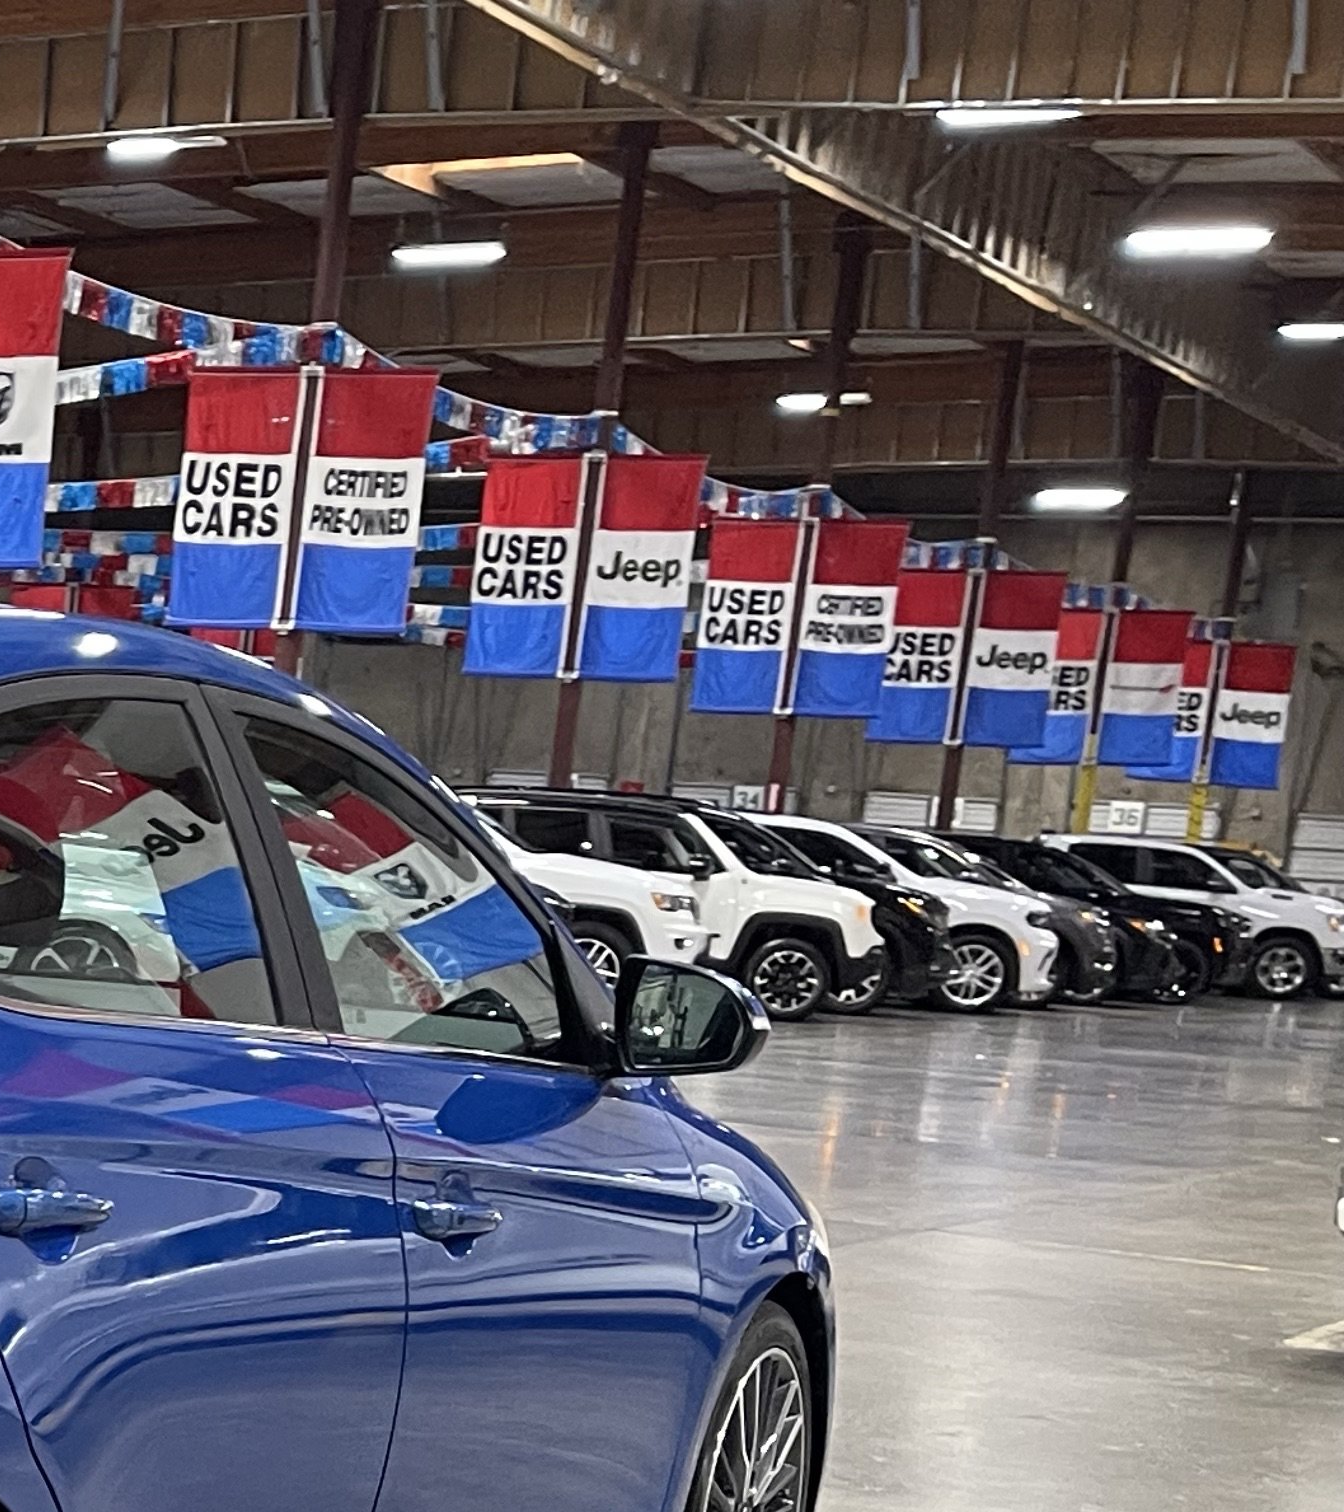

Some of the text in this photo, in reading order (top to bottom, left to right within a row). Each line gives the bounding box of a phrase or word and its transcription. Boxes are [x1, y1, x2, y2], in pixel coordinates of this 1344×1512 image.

[186, 459, 282, 498] USED
[324, 468, 408, 498] CERTIFIED
[182, 499, 279, 537] CARS
[309, 504, 410, 536] PRE-OWNED
[482, 533, 568, 565] USED
[476, 567, 563, 599] CARS
[596, 550, 682, 588] Jeep
[707, 586, 785, 616] USED
[705, 616, 782, 645] CARS
[976, 644, 1048, 674] Jeep
[1220, 703, 1281, 729] Jeep
[736, 791, 760, 811] 34
[1112, 807, 1139, 827] 36
